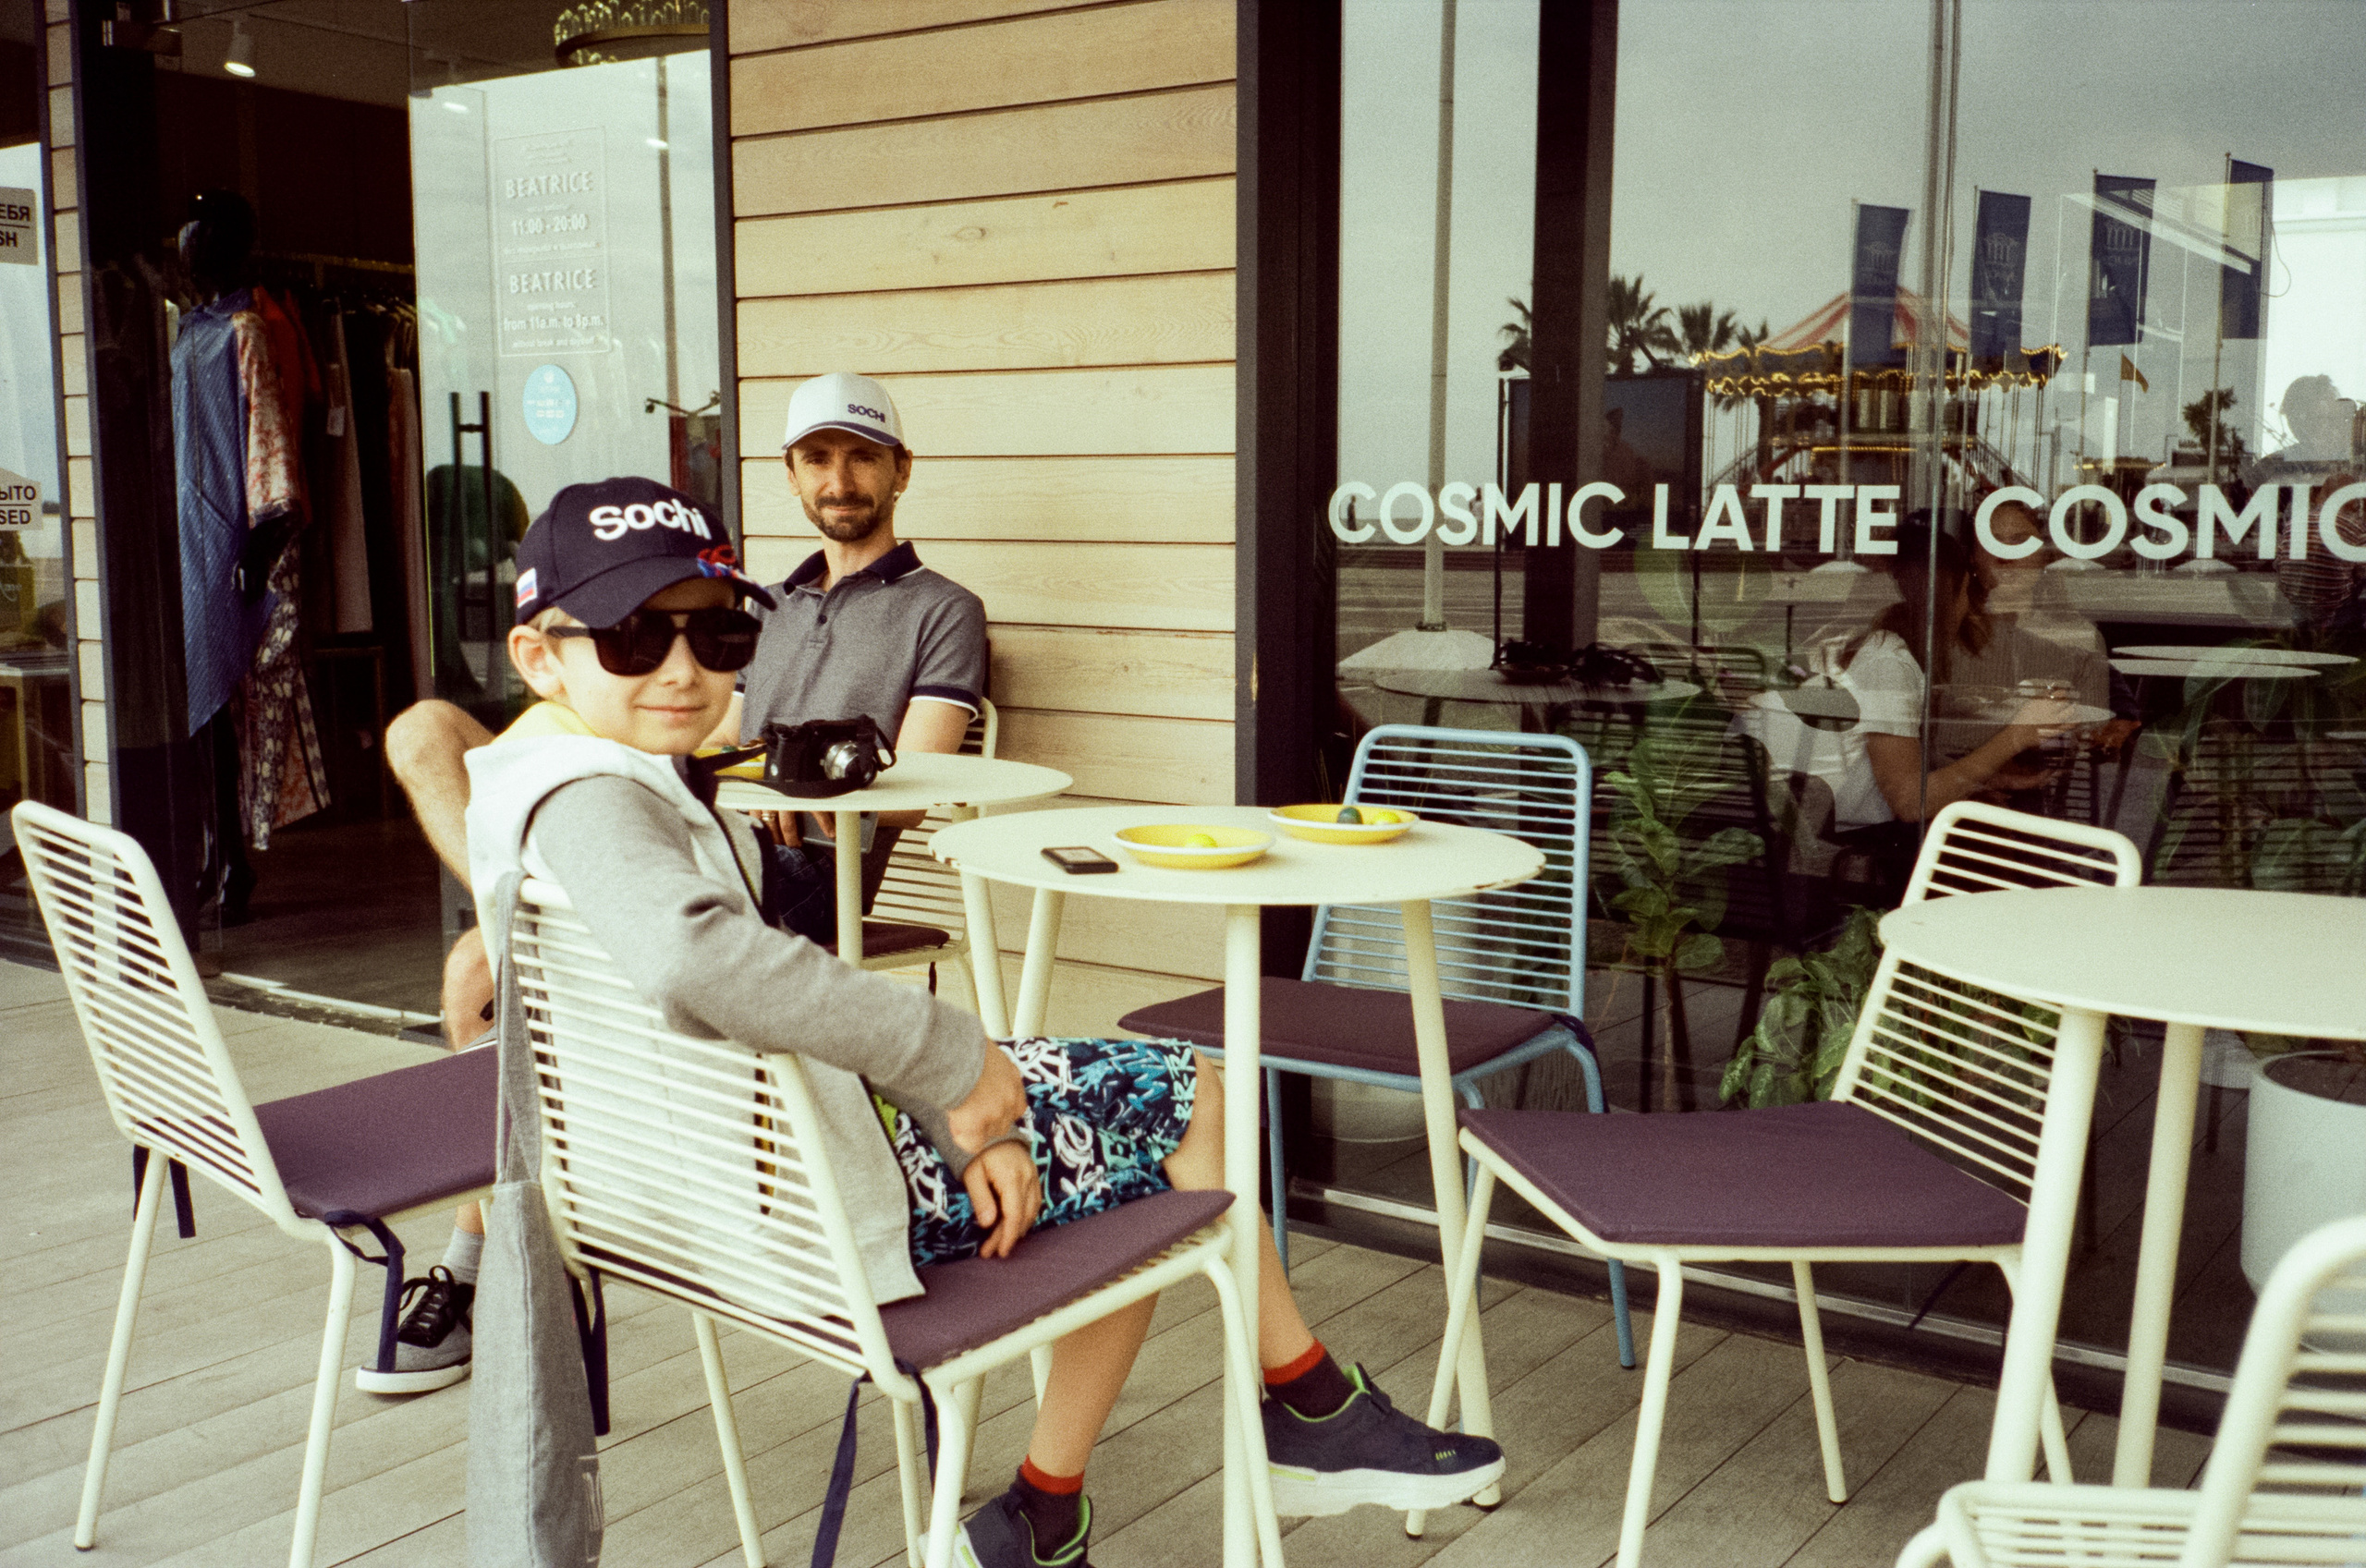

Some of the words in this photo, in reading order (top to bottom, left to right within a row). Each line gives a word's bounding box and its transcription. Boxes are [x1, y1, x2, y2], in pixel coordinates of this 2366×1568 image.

[506, 171, 592, 199] BEATRICE
[512, 217, 543, 236] 11:00
[554, 213, 588, 232] 20:00
[509, 269, 594, 294] BEATRICE
[504, 317, 526, 332] from
[564, 315, 573, 328] to
[848, 404, 886, 423] SOCHI
[0, 509, 31, 525] SED
[1328, 481, 1626, 549] COSMIC
[1653, 483, 1900, 554] LATTE
[1974, 482, 2366, 563] COSMIC
